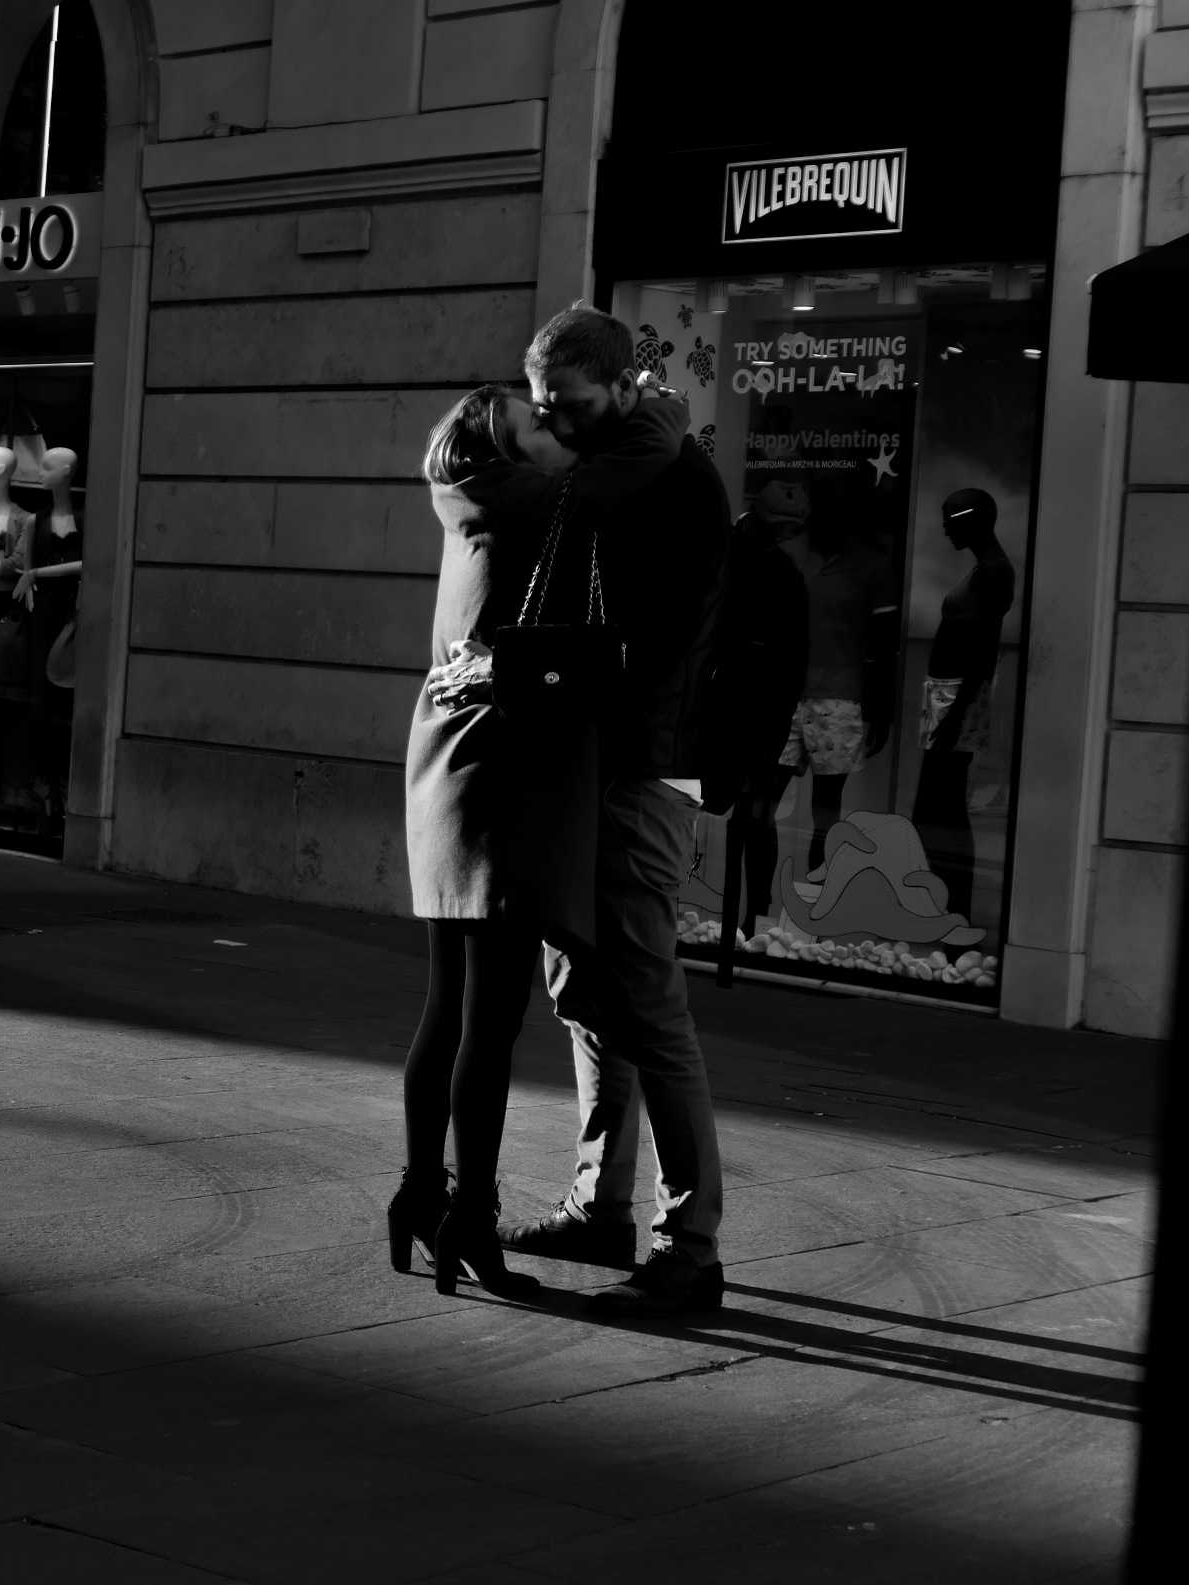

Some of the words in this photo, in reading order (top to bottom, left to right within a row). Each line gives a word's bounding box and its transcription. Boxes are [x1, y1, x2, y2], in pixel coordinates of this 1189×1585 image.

[731, 157, 900, 235] VILEBREQUIN
[734, 342, 774, 361] TRY
[778, 336, 907, 360] SOMETHING
[745, 460, 786, 469] VILEBREQUIN
[815, 460, 821, 468] &
[821, 460, 857, 469] MORICEAU
